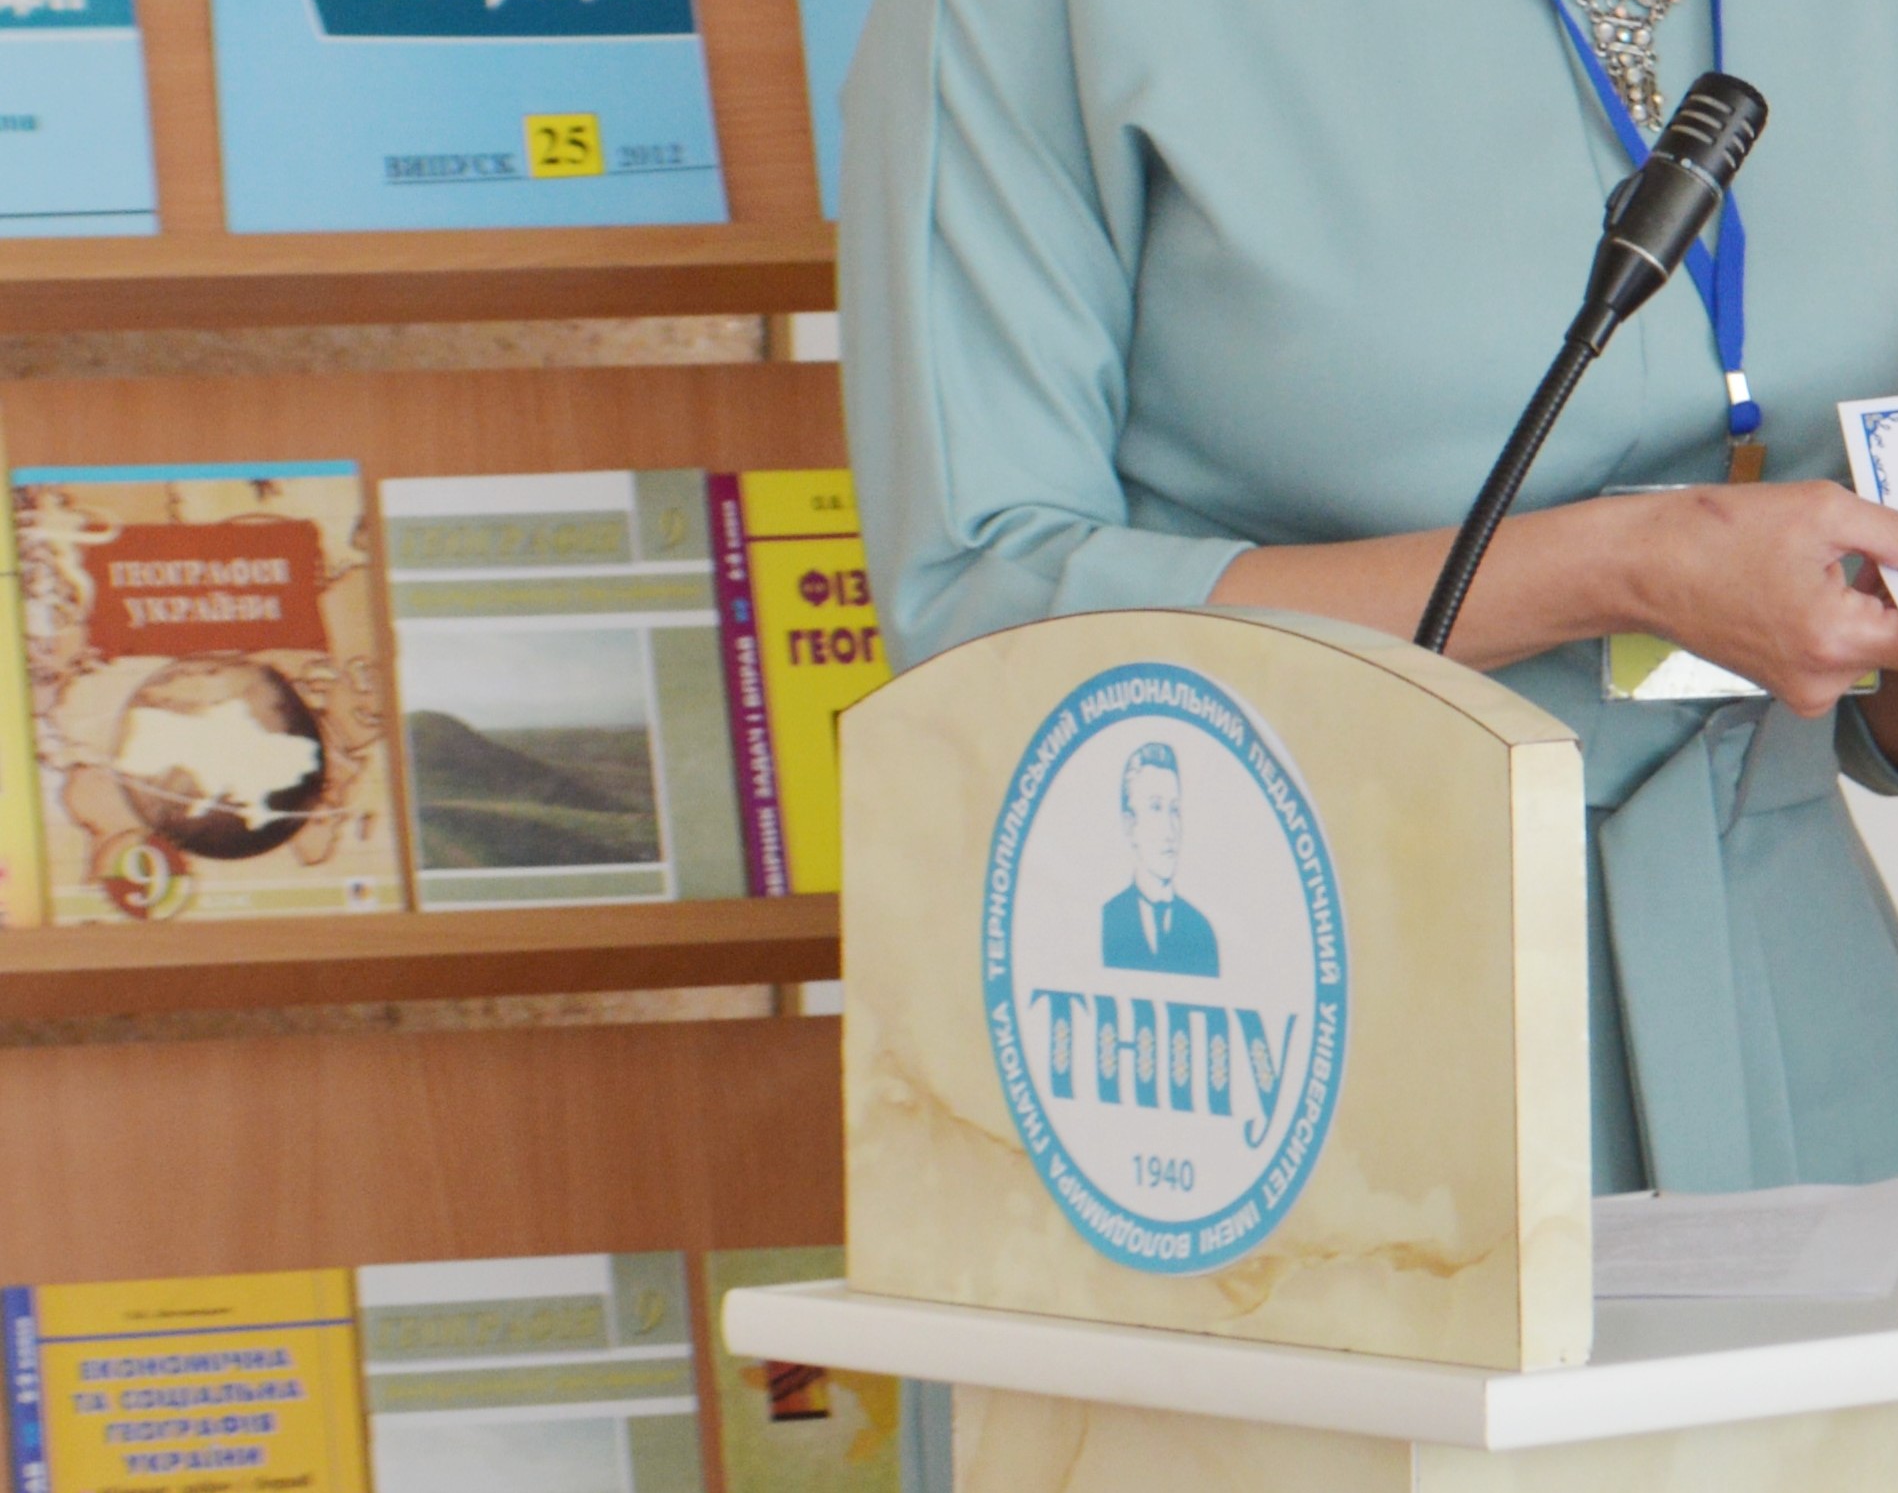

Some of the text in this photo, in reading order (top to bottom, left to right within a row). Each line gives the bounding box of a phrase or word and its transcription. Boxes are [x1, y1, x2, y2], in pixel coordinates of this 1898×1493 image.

[537, 125, 590, 166] 25
[121, 844, 171, 907] 9
[987, 678, 1341, 1259] ТЕРНОПІЛЬСЬКИЙ НАЦІОНАЛЬНИЙ ПЕДАГОГІЧНИЙ УНІВЕРСИТЕТ ІМЕНІ ВОЛОДИМИРА ГНАТЮКА
[1028, 988, 1298, 1149] ТНПУ
[1132, 1154, 1195, 1192] 1940
[80, 1347, 295, 1381] ЕКОНОМІЧНА
[121, 1378, 308, 1411] СОЦІАЛЬНА
[106, 1410, 279, 1443] ГЕОГРАФІЯ
[123, 1444, 268, 1474] УКРАЇНИ
